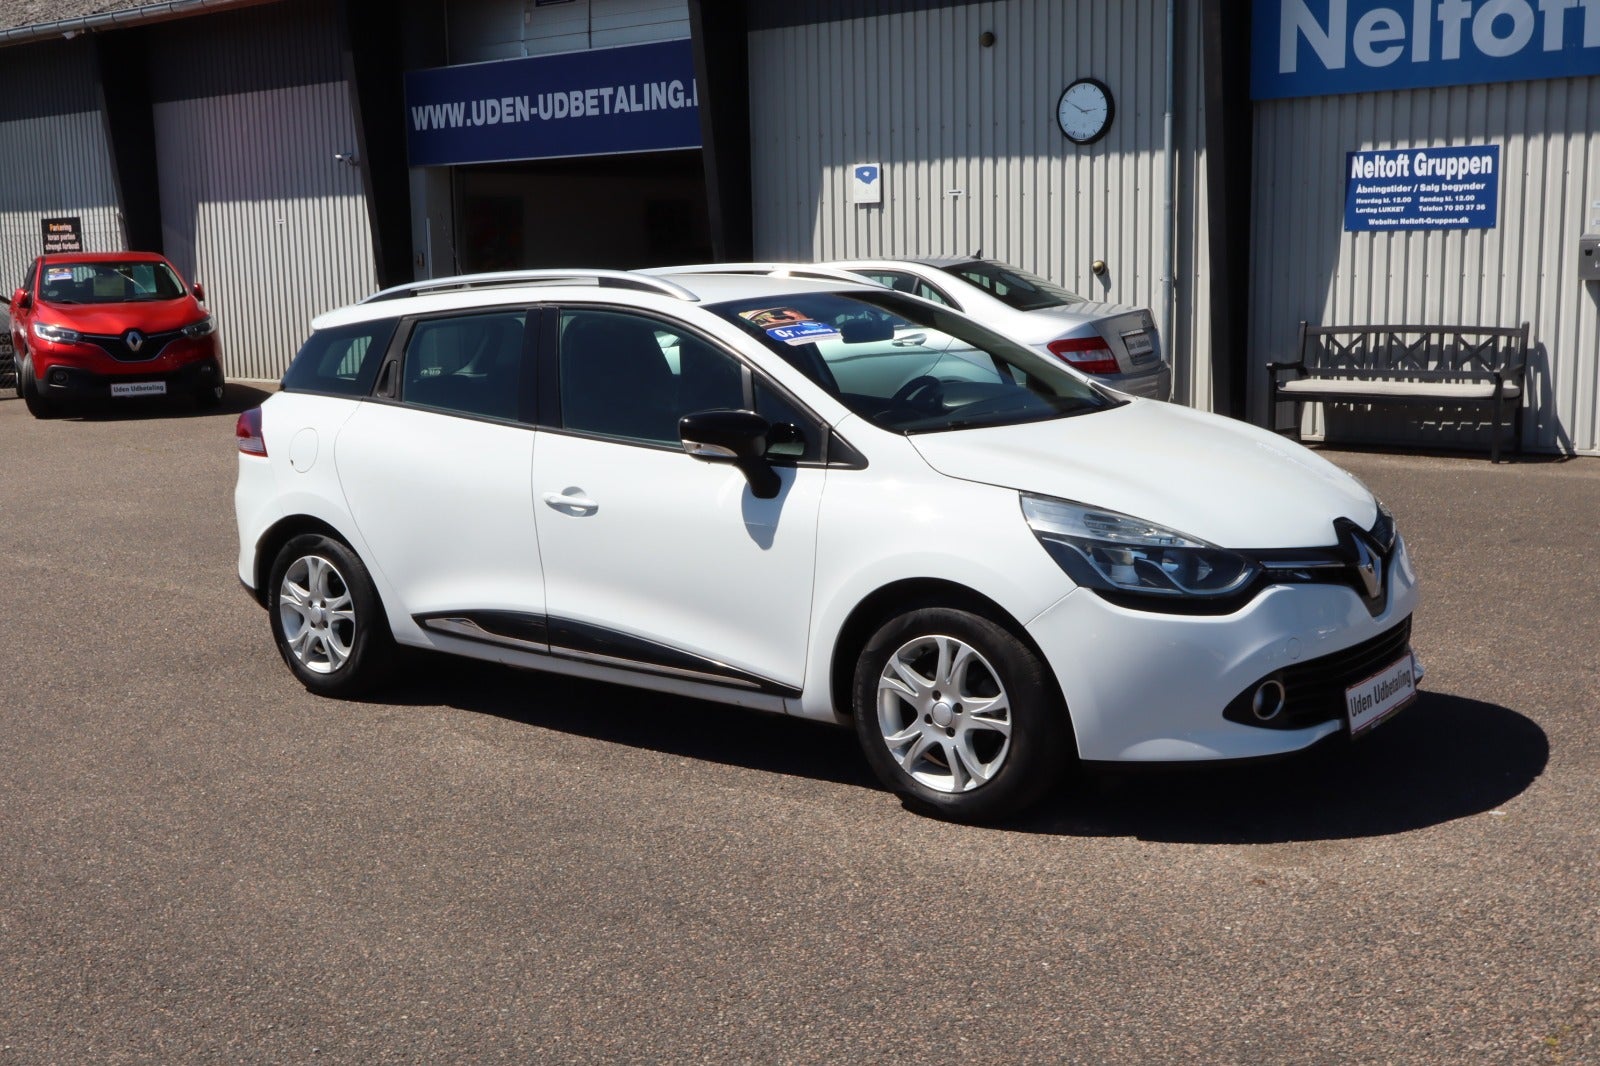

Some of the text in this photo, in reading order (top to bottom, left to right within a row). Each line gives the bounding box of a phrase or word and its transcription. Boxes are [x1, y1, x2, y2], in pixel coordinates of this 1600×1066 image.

[1351, 152, 1493, 180] Neltoft Gruppen
[1356, 182, 1486, 195] Åbningstider / Salg begynder
[1392, 196, 1412, 204] 12.00
[1454, 194, 1475, 202] 12.00
[1400, 216, 1469, 225] Neltoft-Gruppen.dk
[130, 384, 164, 392] Udbetaling
[1350, 669, 1412, 717] Uden Udbetaling
